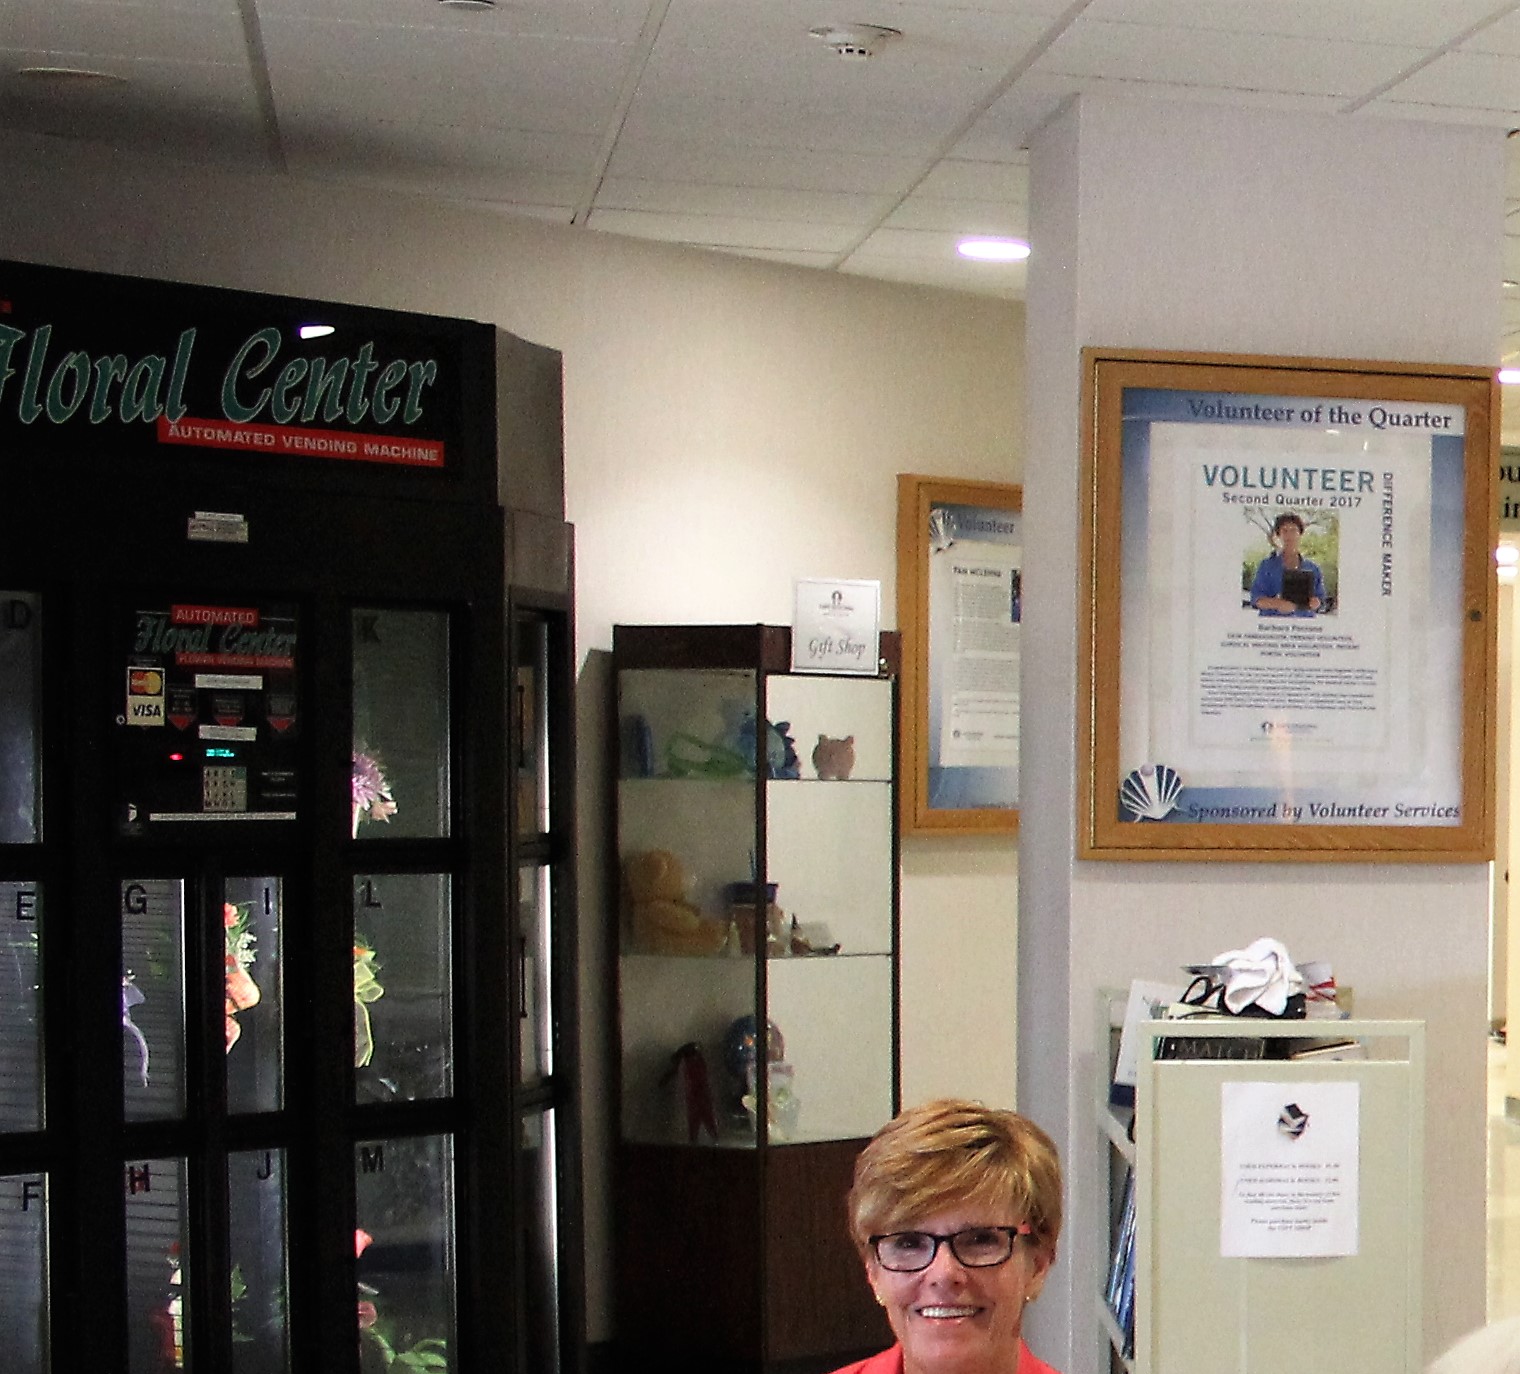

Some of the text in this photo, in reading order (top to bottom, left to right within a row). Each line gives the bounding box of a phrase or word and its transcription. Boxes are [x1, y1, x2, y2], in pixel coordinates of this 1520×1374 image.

[221, 327, 437, 424] Center
[1188, 400, 1452, 430] Volunteer of the Quarter
[168, 423, 438, 462] AUTOMATED VENDING MACHINE
[1202, 463, 1375, 494] VOLUNTEER
[1222, 490, 1362, 509] Second Quarter 2017
[1381, 472, 1393, 597] DIFFERENCE MAKER
[9, 602, 31, 629] D
[175, 608, 255, 624] AUTOMATED
[134, 615, 297, 658] Floral Center
[809, 636, 866, 660] Gift Shop
[133, 704, 162, 718] VISA
[1187, 802, 1460, 823] Sponsored by Volunteer Services
[15, 890, 36, 921] E
[125, 884, 148, 914] G
[364, 881, 381, 909] L
[257, 1150, 271, 1180] J
[362, 1146, 384, 1174] M
[129, 1163, 150, 1194] H
[22, 1181, 40, 1212] F
